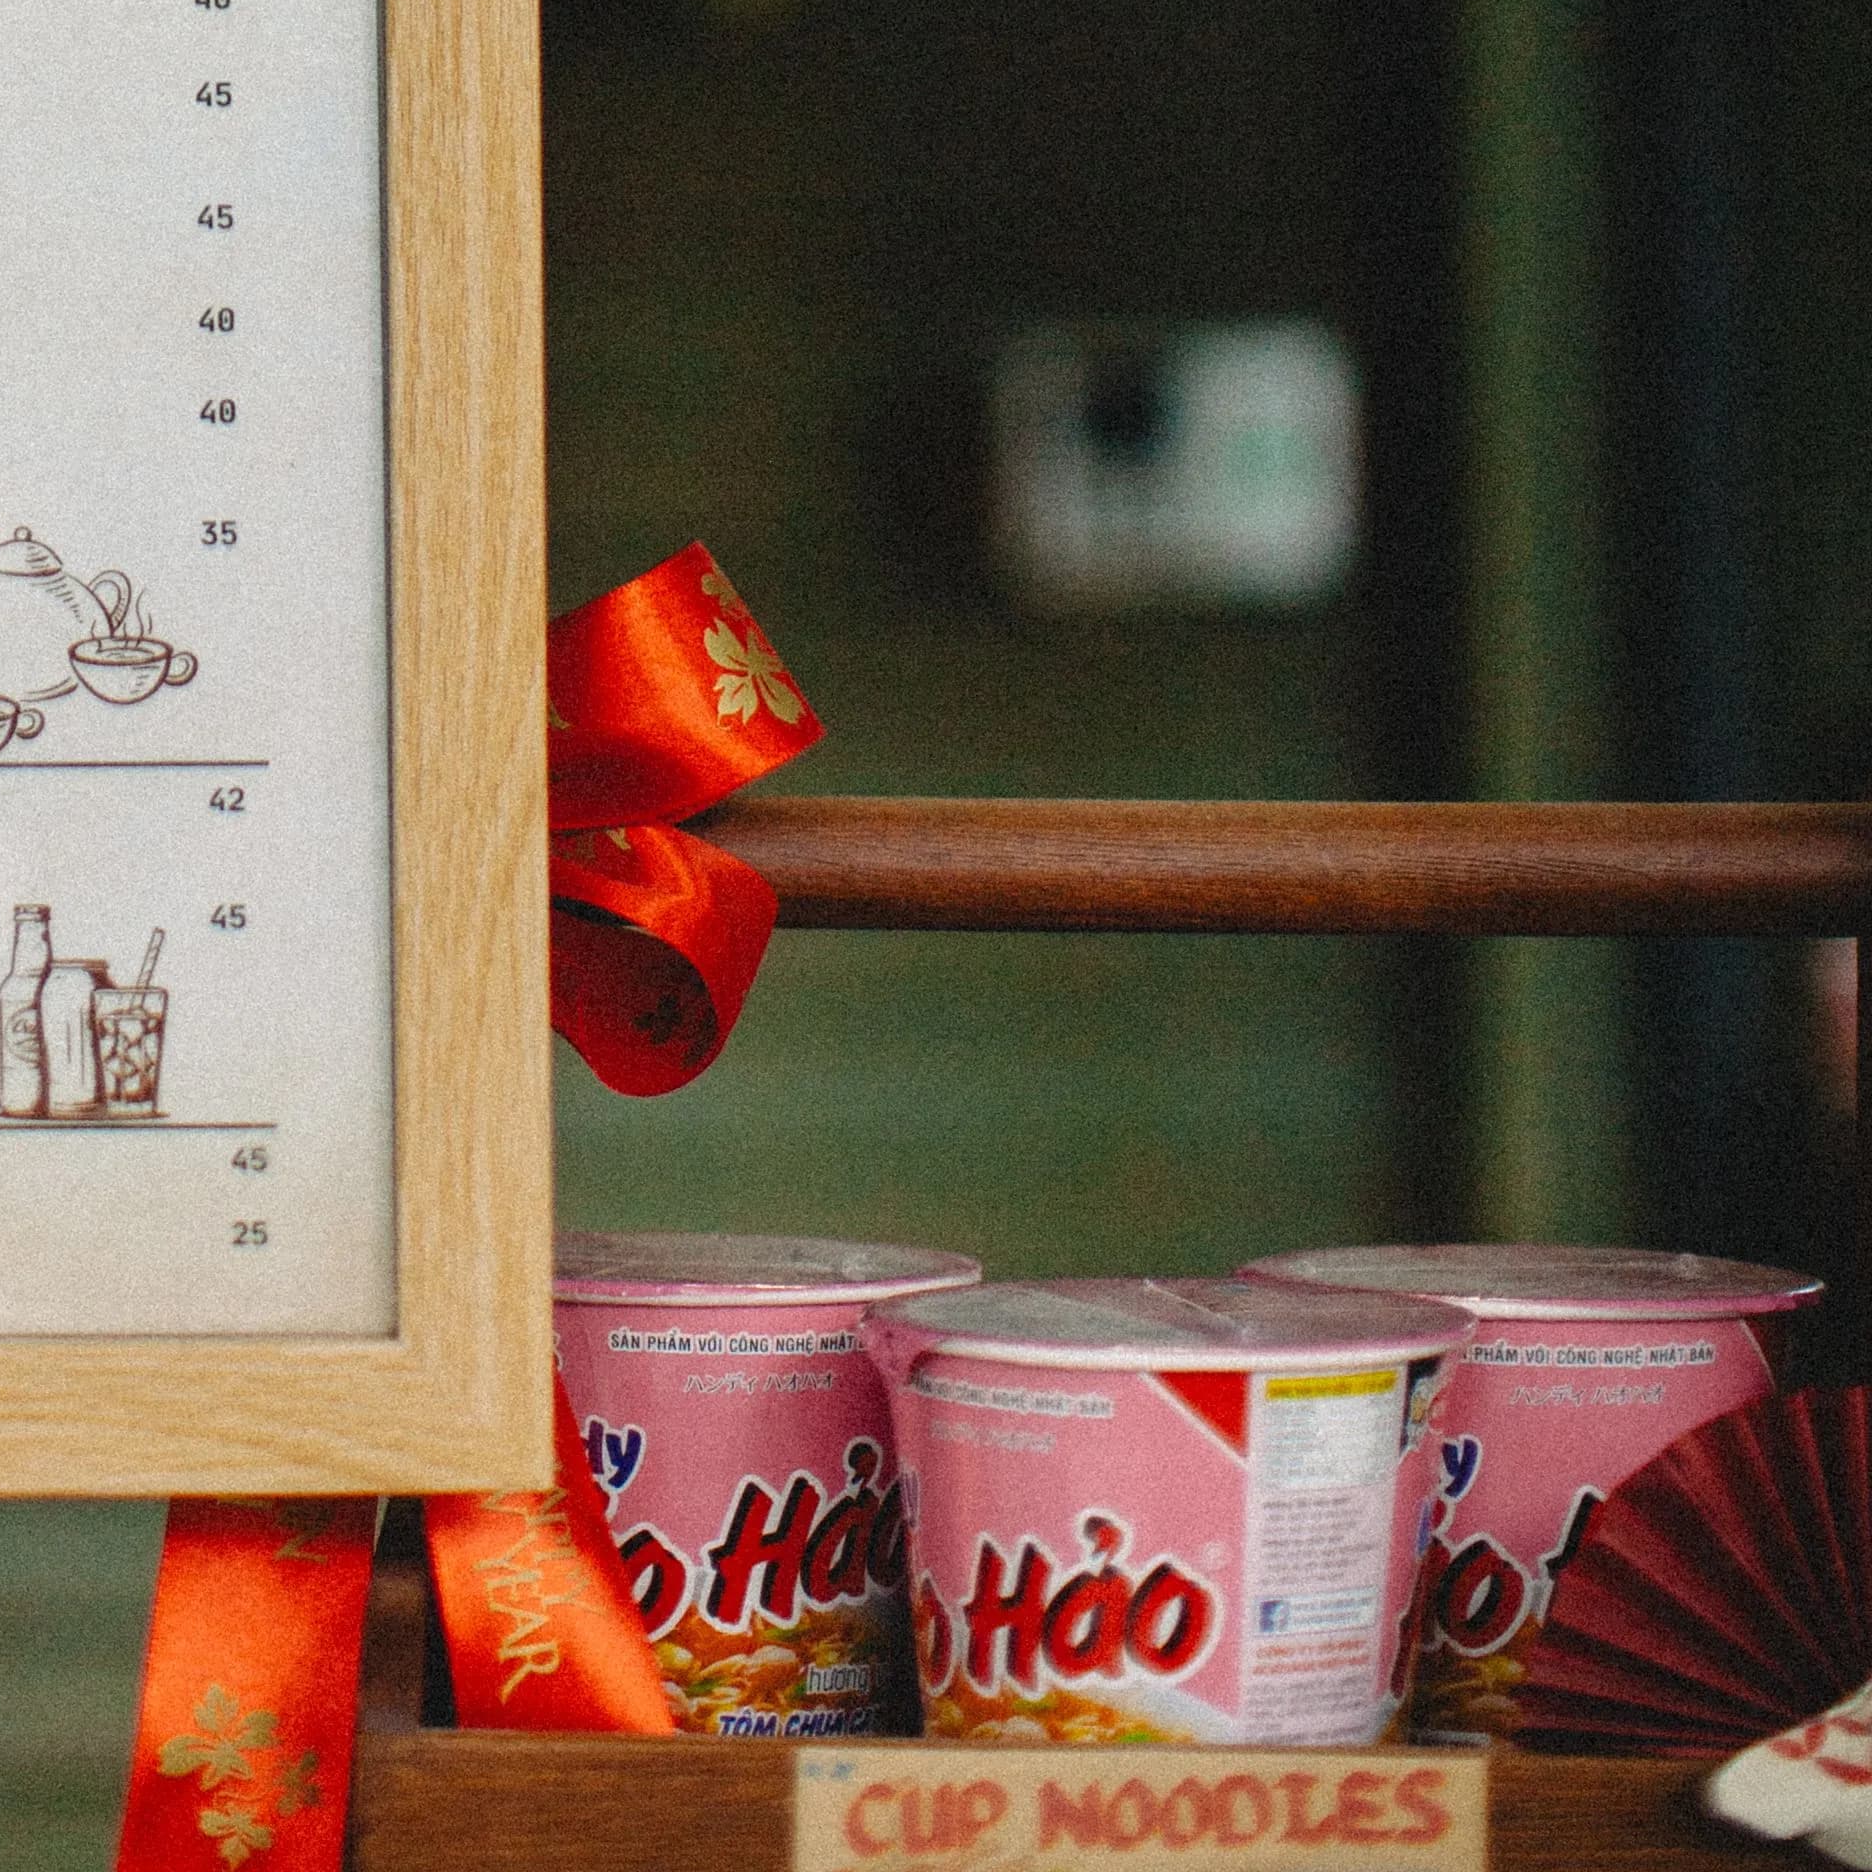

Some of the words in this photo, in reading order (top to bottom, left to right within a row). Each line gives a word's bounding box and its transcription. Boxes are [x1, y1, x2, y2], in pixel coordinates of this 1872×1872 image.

[195, 81, 233, 109] 45
[230, 1145, 269, 1173] 45
[231, 1220, 269, 1247] 25
[962, 1514, 1214, 1692] Hảo
[842, 1777, 1008, 1858] CUP
[1035, 1768, 1453, 1852] NOODLES
